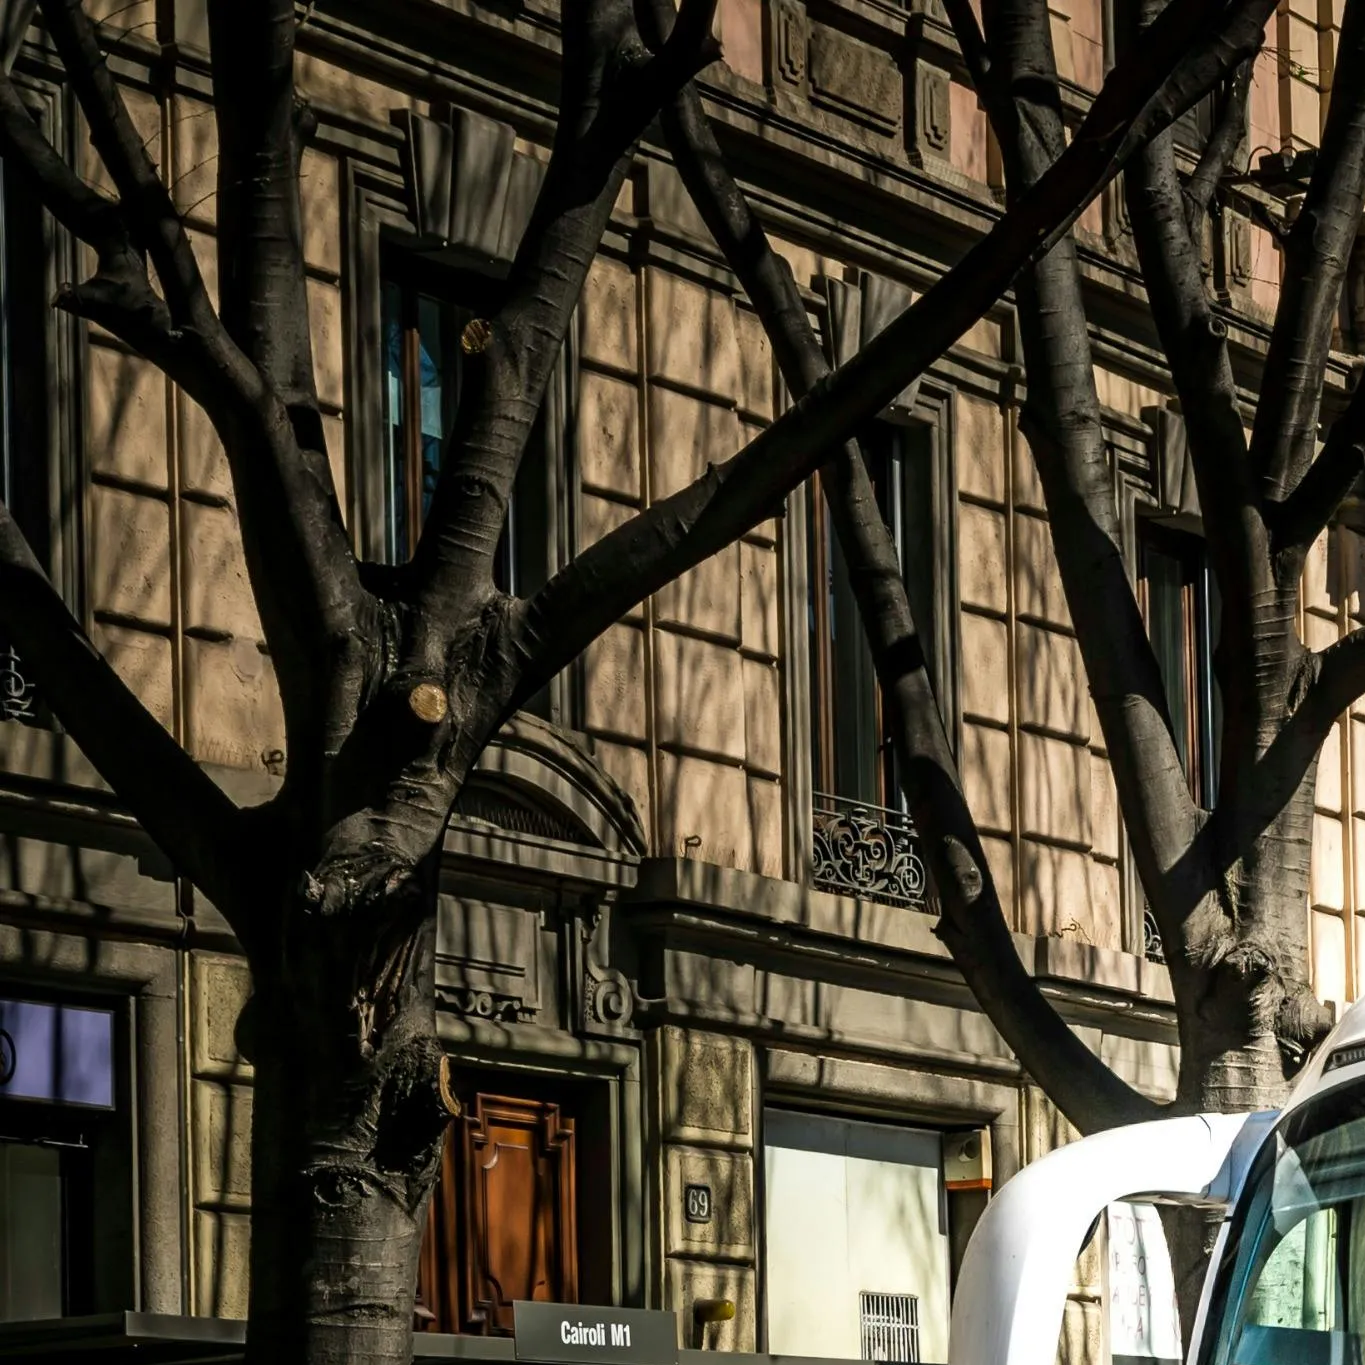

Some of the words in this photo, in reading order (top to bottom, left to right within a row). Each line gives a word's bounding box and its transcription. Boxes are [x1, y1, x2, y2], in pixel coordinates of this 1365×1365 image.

[688, 1189, 708, 1217] 69
[560, 1320, 605, 1346] Cairoli
[610, 1323, 631, 1347] M1
